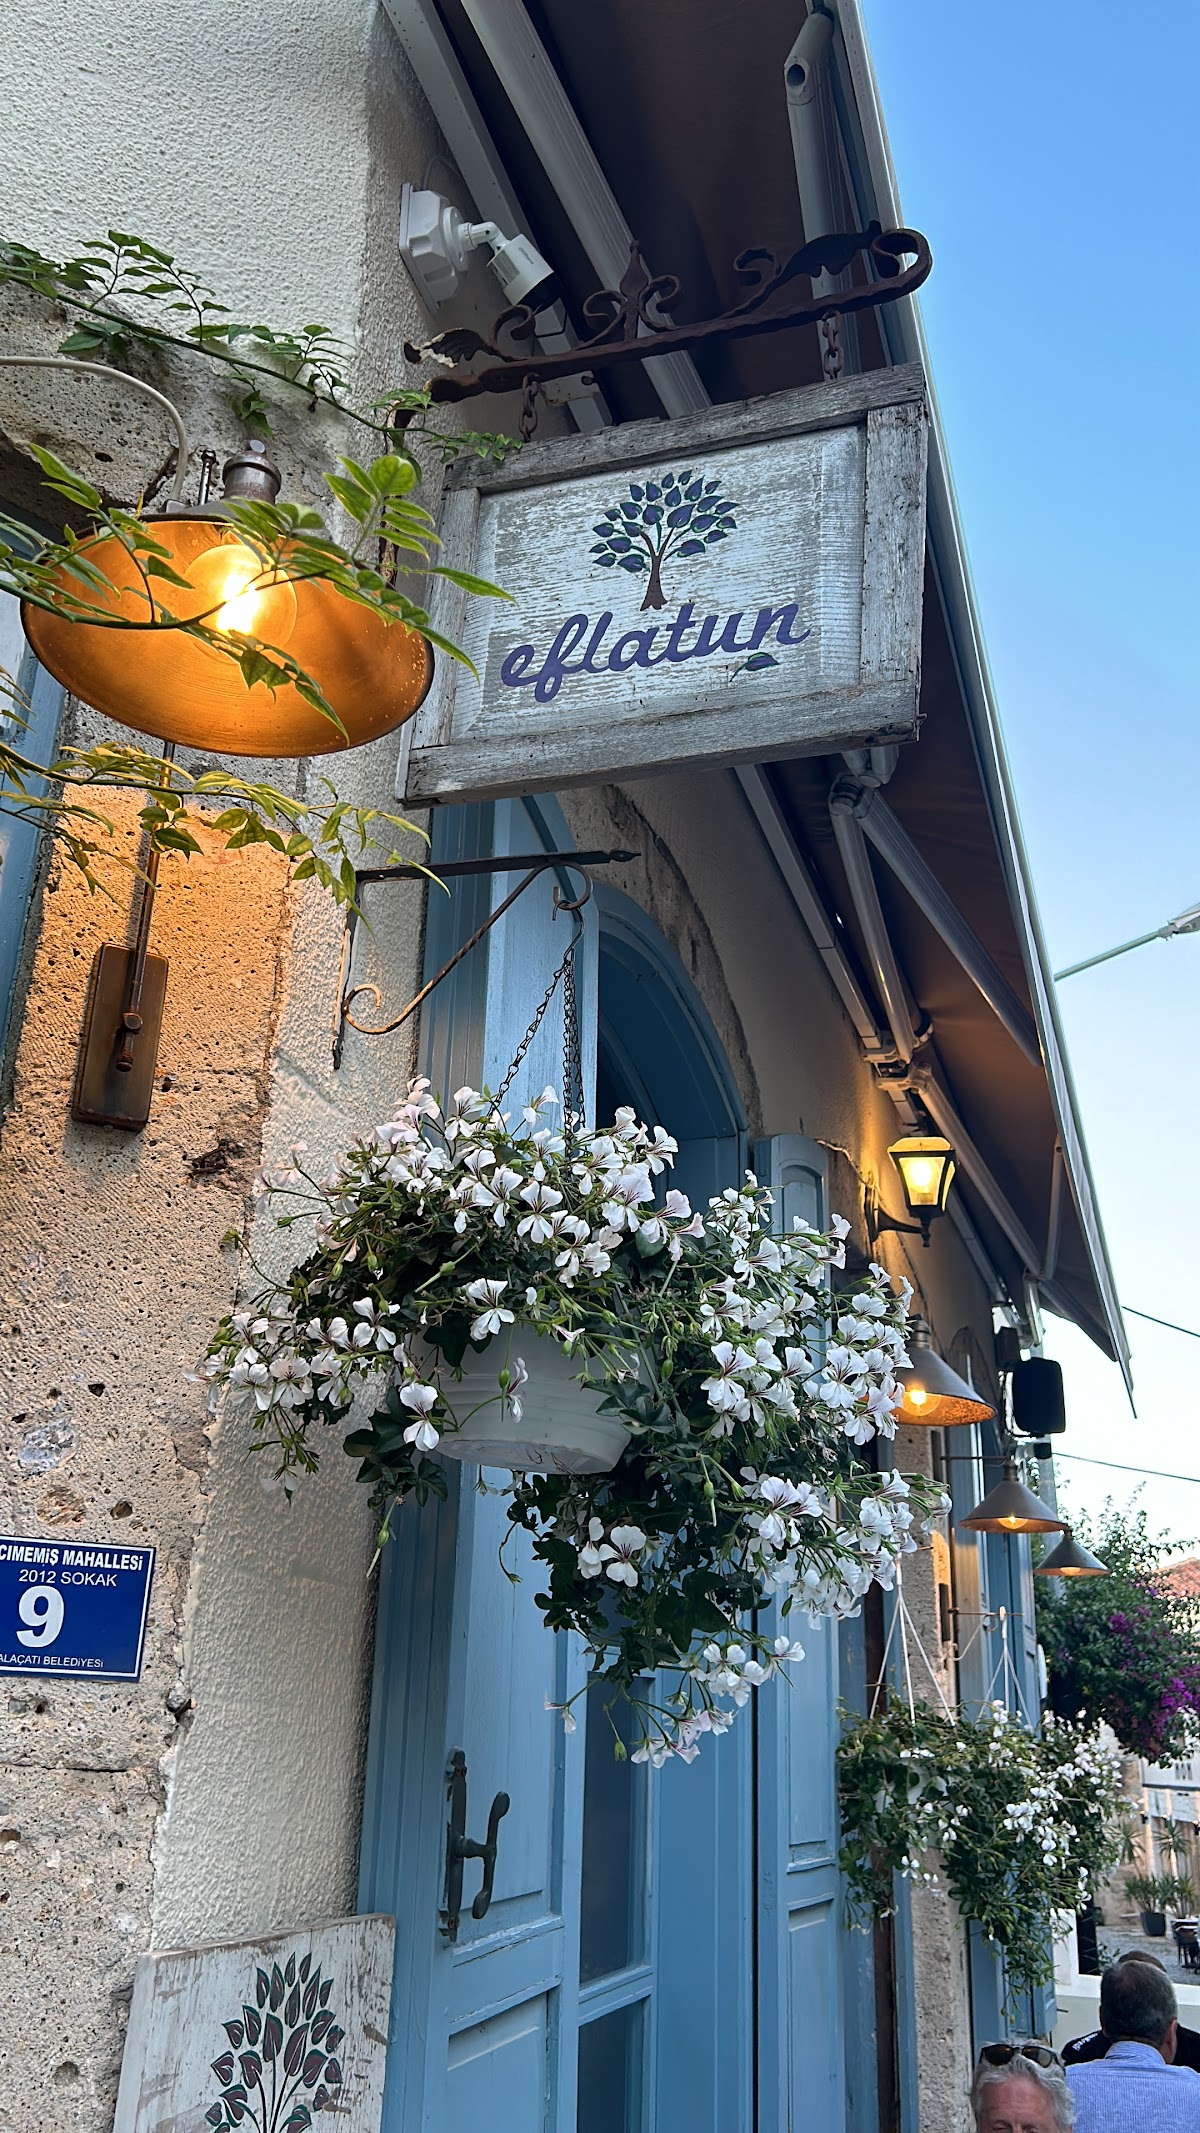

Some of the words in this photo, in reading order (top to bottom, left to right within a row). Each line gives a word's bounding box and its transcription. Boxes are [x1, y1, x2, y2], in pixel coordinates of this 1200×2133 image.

[501, 602, 811, 703] eflatun
[18, 1569, 56, 1584] 2012
[60, 1572, 118, 1587] SOKAK
[16, 1585, 65, 1648] 9
